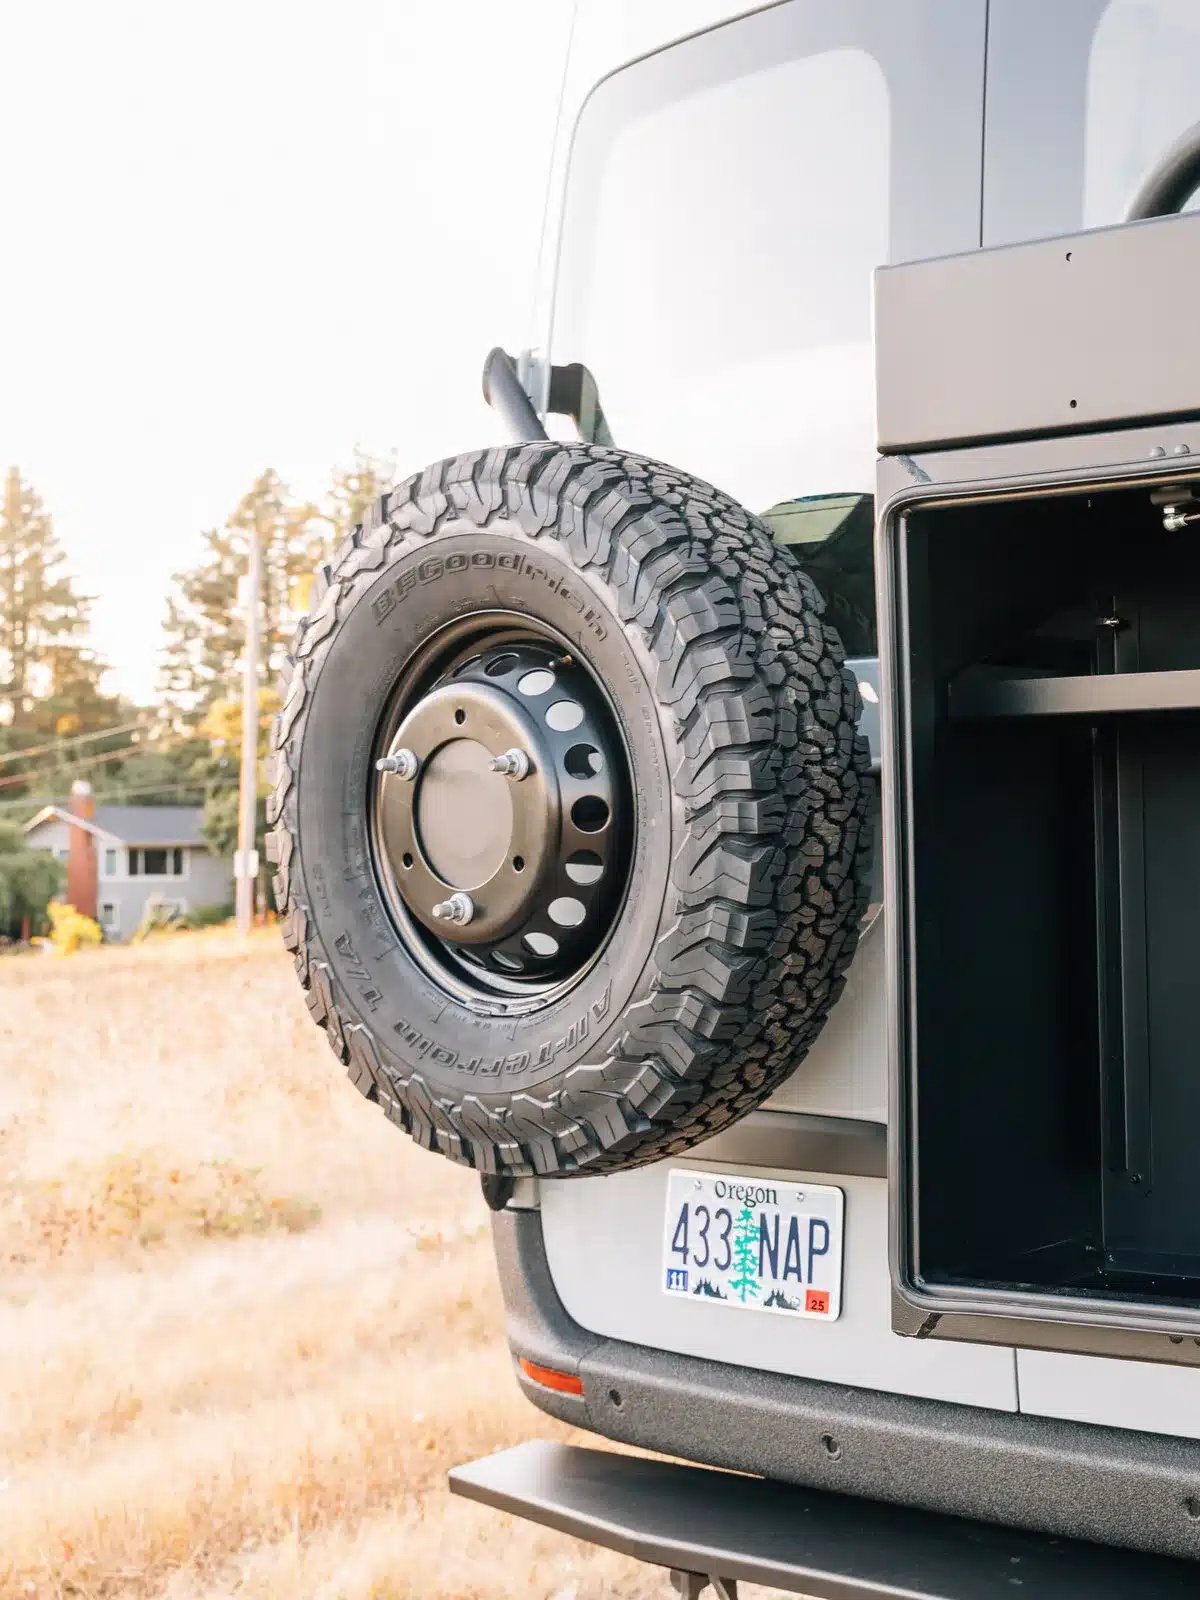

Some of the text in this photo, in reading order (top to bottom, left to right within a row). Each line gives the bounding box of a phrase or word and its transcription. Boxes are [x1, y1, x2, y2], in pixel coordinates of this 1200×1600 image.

[372, 551, 608, 642] BFGoodrich
[394, 978, 612, 1078] All-Terrain
[714, 1180, 779, 1208] Oregon
[671, 1202, 830, 1285] 433 NAP
[669, 1272, 685, 1289] 11
[810, 1299, 825, 1312] 25
